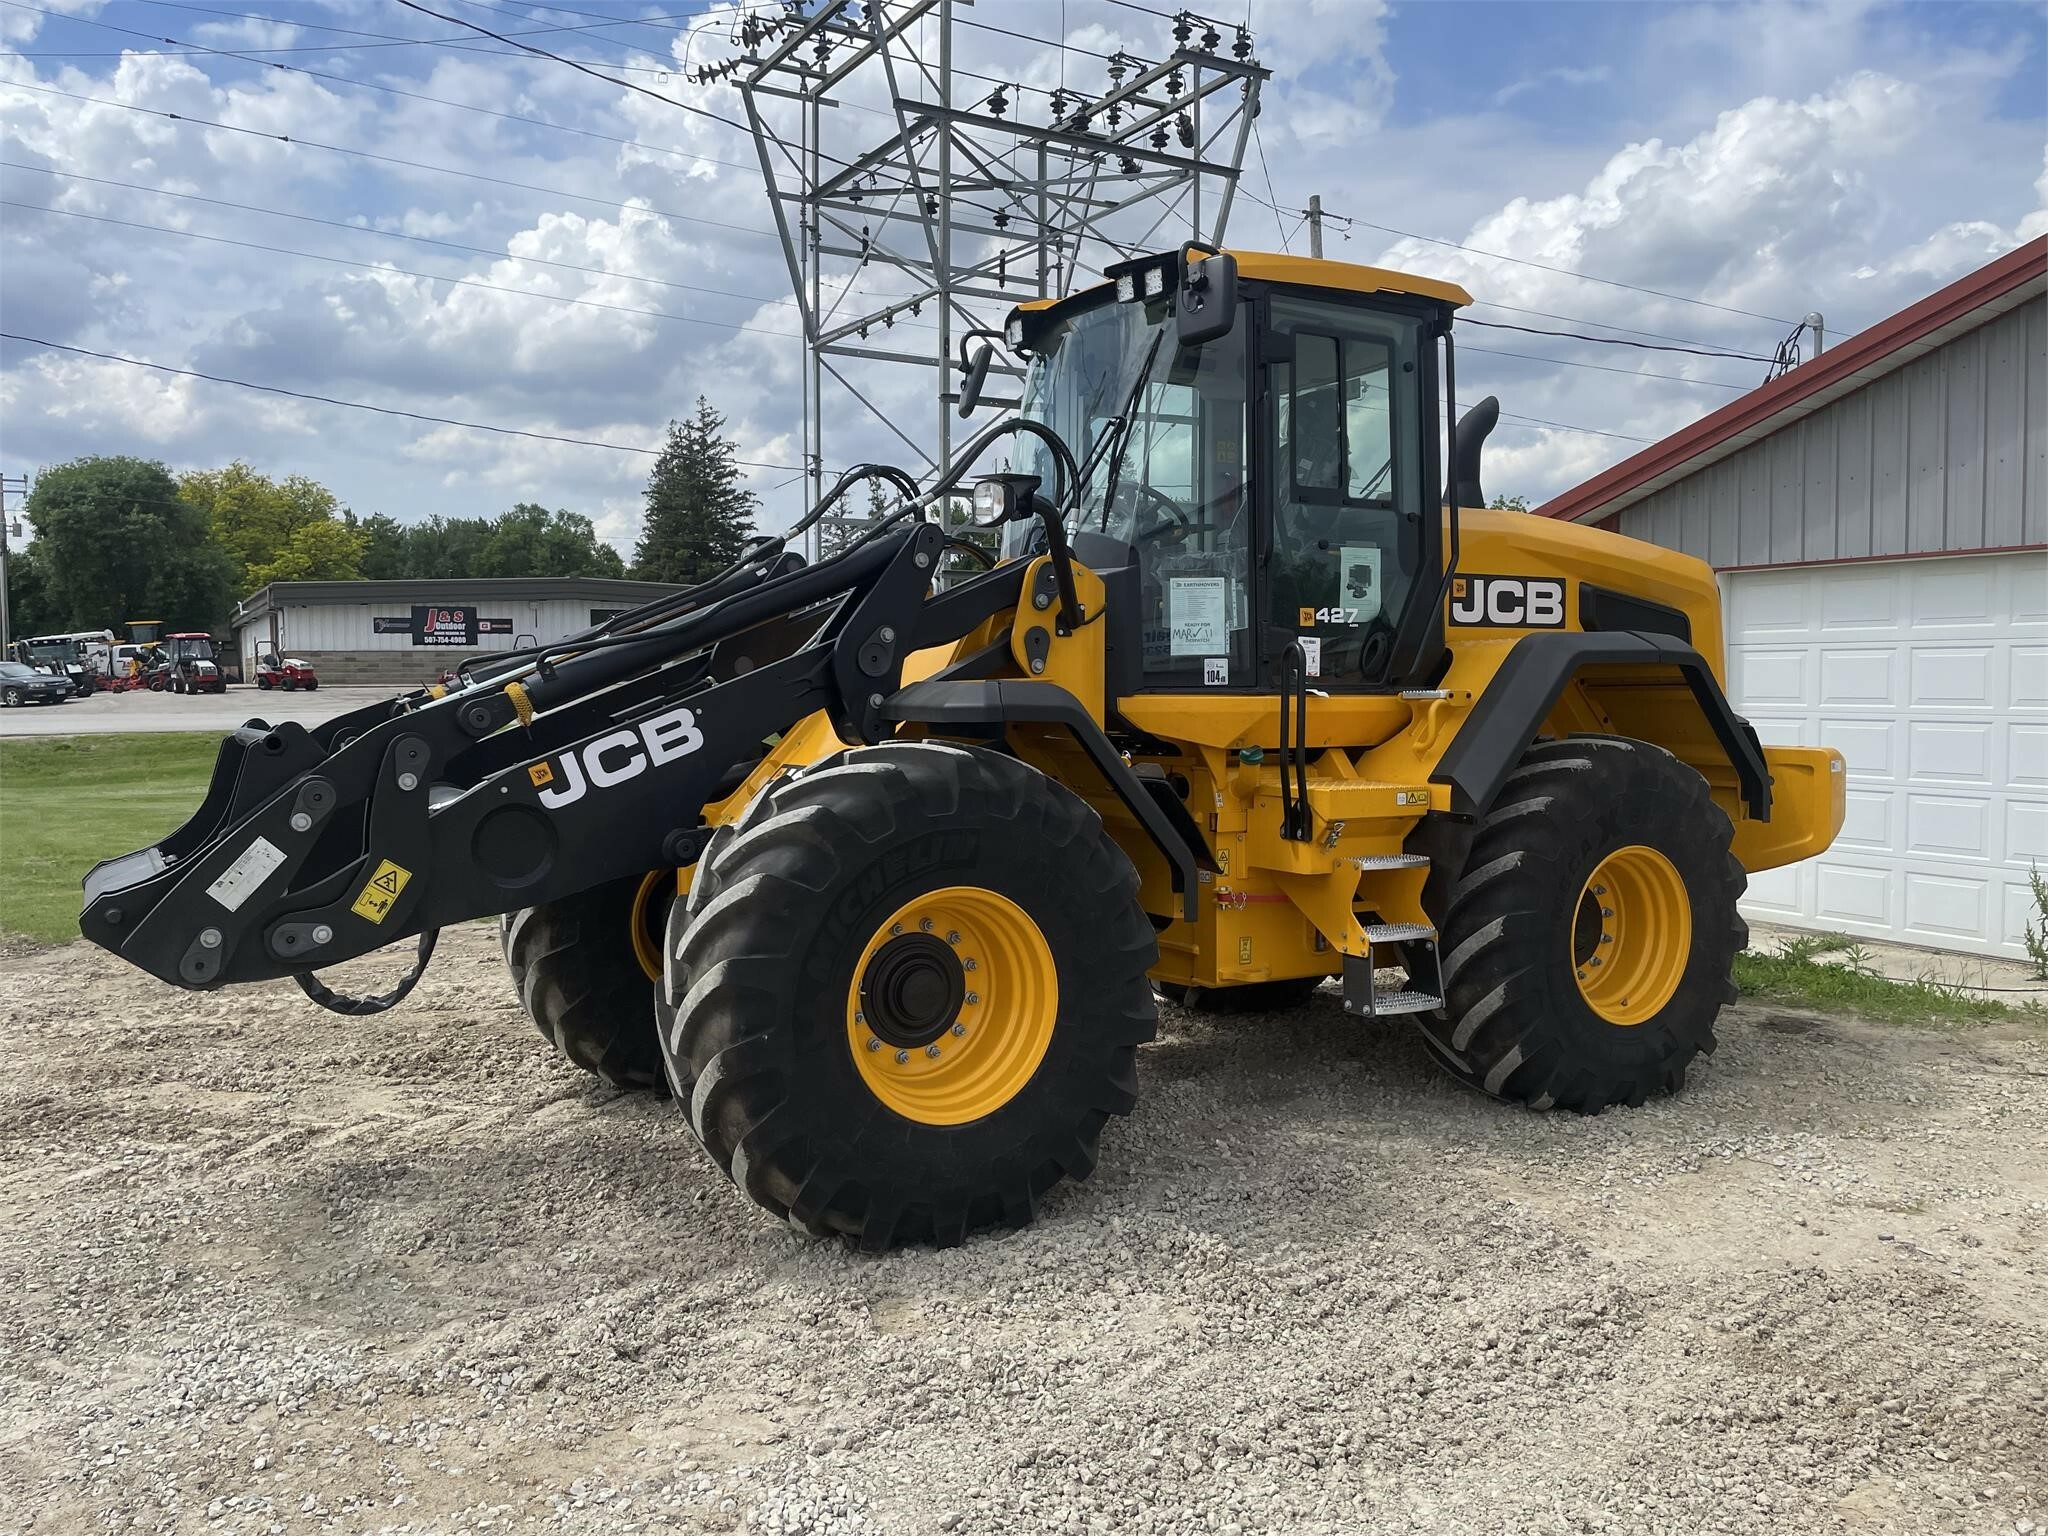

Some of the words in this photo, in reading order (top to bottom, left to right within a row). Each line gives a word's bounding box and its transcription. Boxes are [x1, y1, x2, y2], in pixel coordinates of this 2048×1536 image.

[1452, 580, 1563, 624] JCB
[424, 608, 437, 632] J
[439, 610, 450, 622] &
[453, 610, 464, 622] S
[1315, 607, 1359, 624] 427
[435, 622, 466, 630] Outdoor
[1206, 670, 1220, 682] 104
[537, 708, 704, 810] JCB
